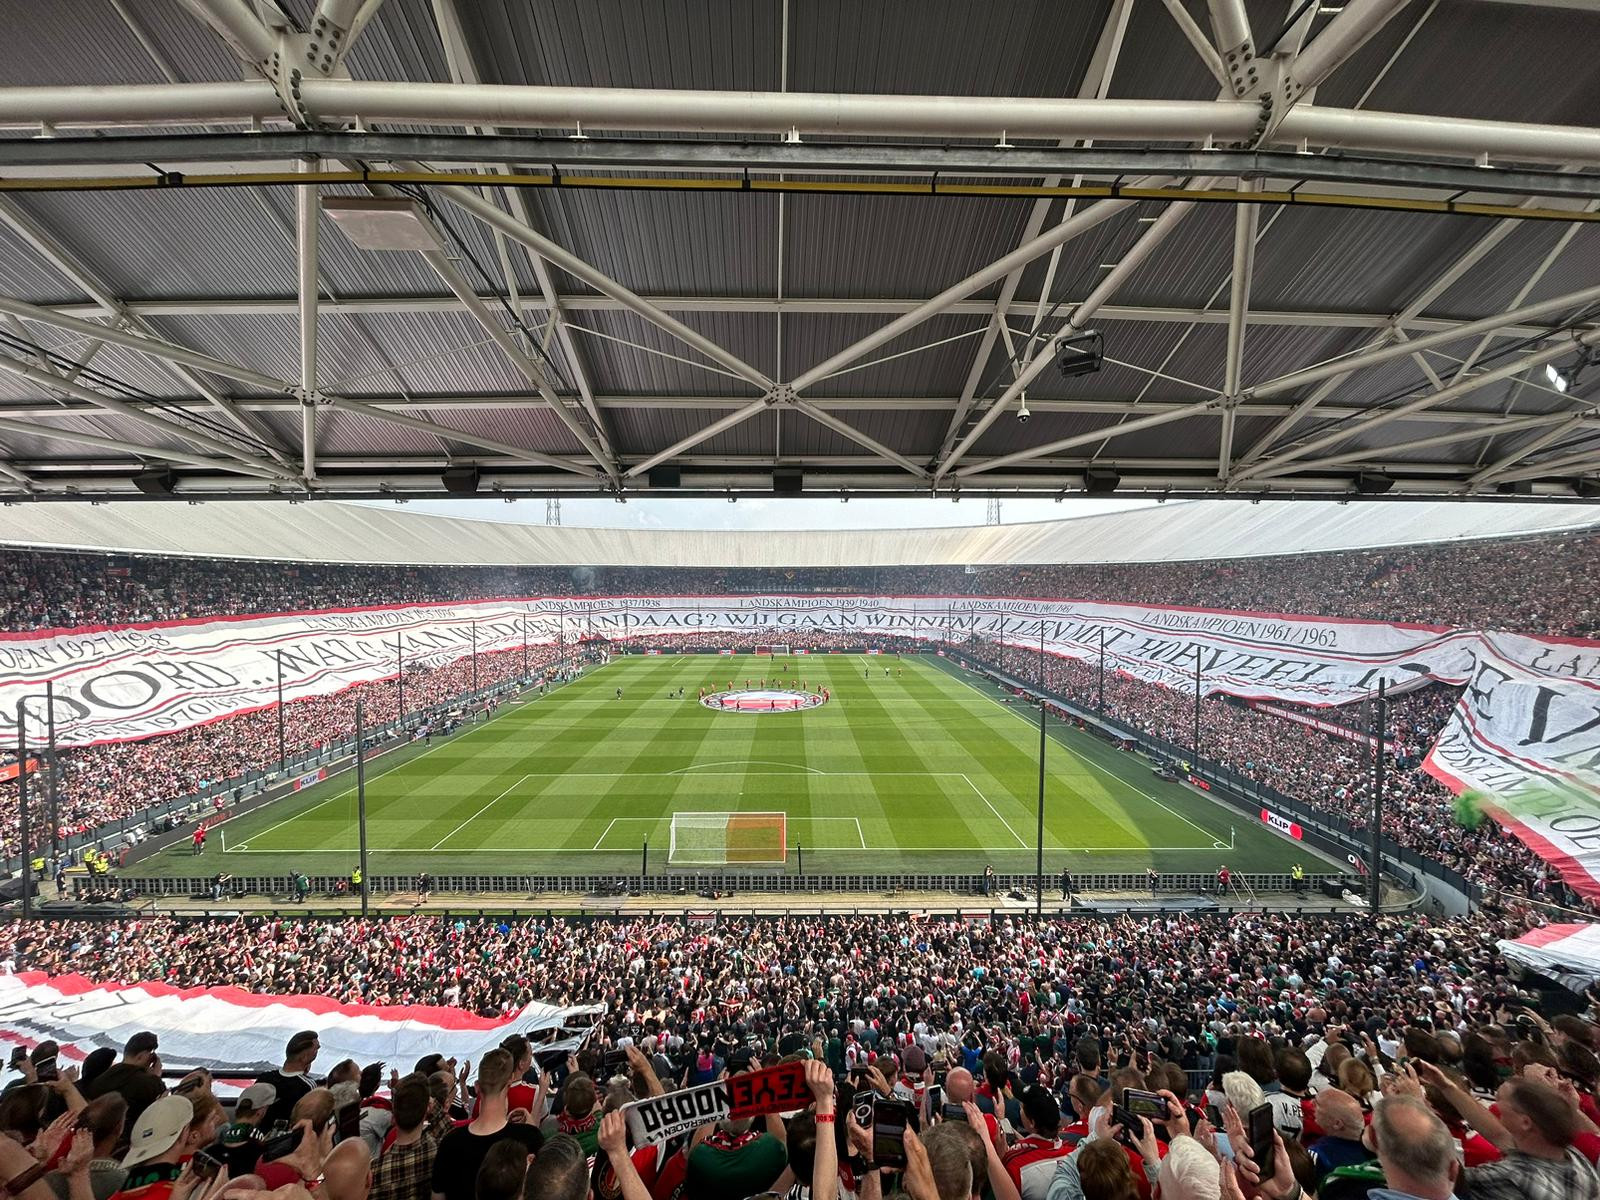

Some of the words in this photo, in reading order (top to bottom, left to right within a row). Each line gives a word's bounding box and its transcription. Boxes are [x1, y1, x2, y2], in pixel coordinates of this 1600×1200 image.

[620, 598, 661, 608] 1937/1938
[740, 598, 833, 608] LANDSKAMPIOEN
[836, 599, 879, 608] 1939/1940
[1141, 612, 1262, 639] LANDSKAMPIOEN
[1259, 623, 1338, 648] 1961/1962
[57, 632, 170, 660] 1927/198
[258, 639, 365, 675] WAT
[568, 612, 716, 629] VANDAAG?
[725, 612, 768, 626] WIJ
[777, 612, 857, 626] GAAN
[1062, 624, 1136, 650] MET
[1121, 637, 1336, 684] HOEVEEL
[1268, 814, 1289, 829] KLIP
[663, 1113, 725, 1137] KAMERADEN
